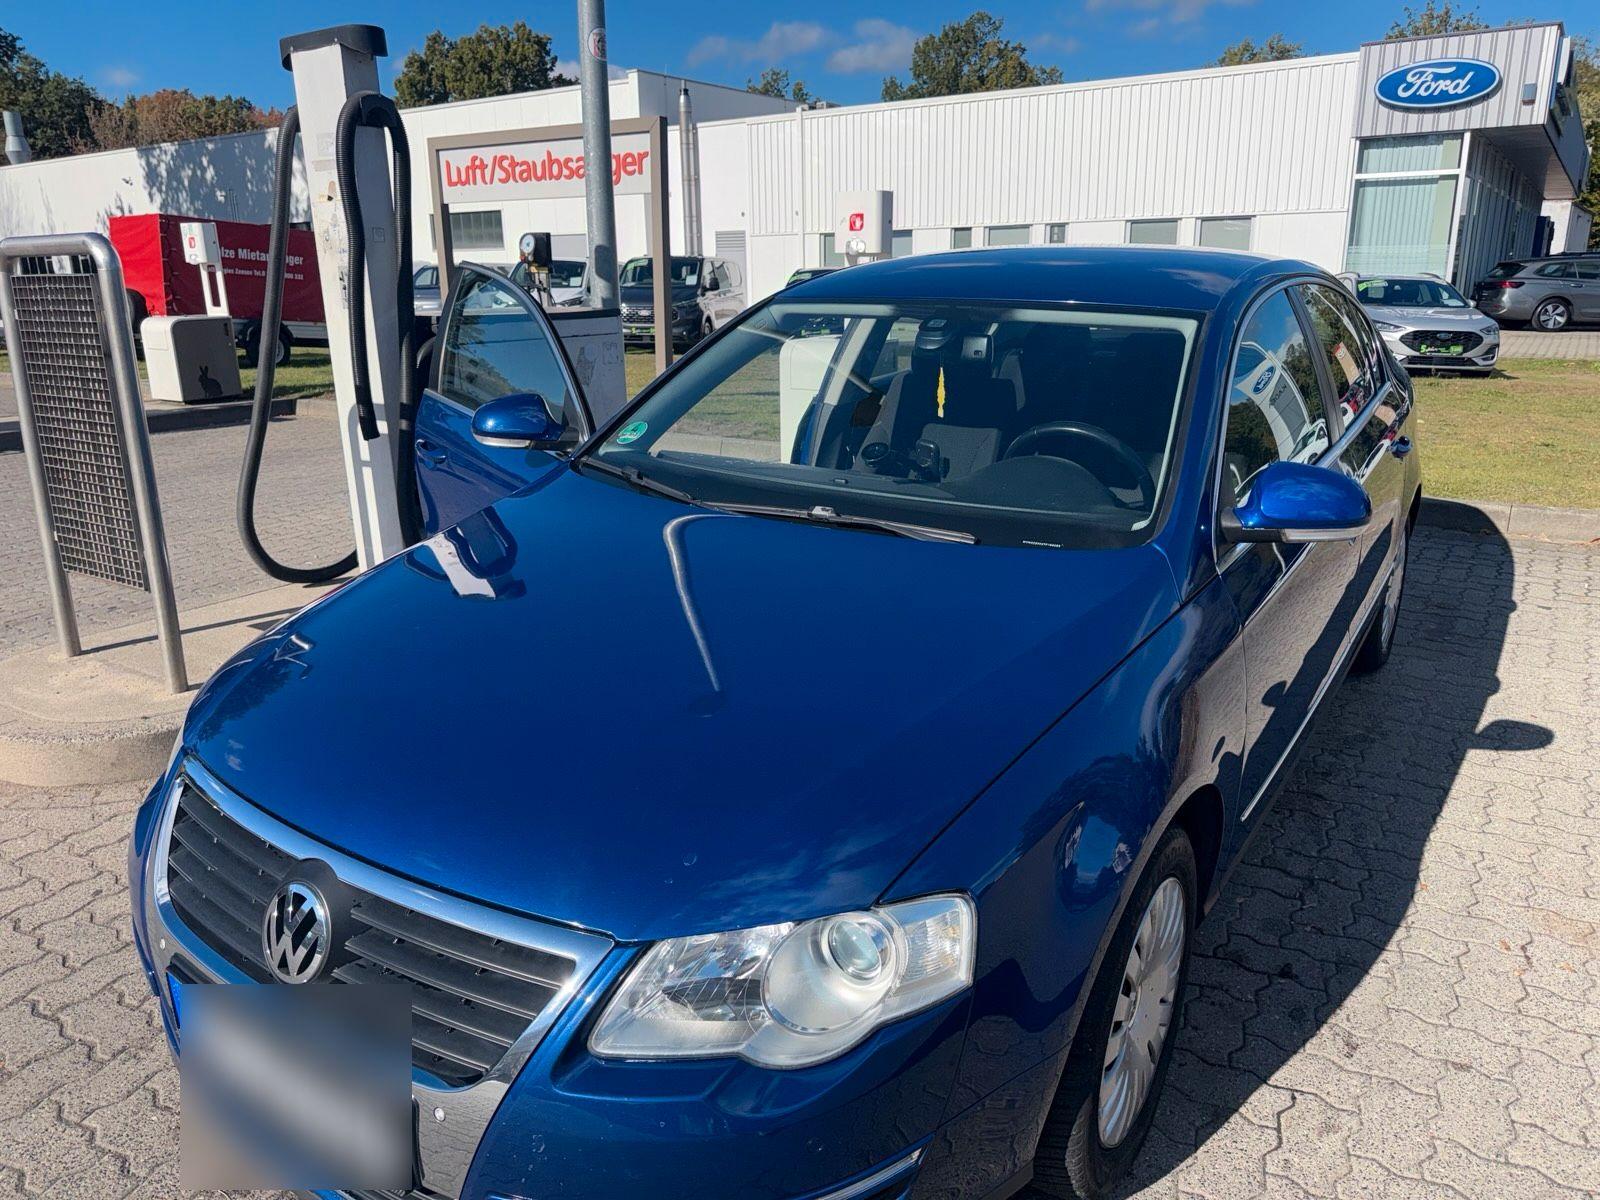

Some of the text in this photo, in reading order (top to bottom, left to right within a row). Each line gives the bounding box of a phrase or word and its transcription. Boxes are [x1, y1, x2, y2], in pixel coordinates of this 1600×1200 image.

[1397, 66, 1475, 98] Ford
[445, 150, 649, 187] Luft/Staubsager
[238, 248, 304, 266] Mietager
[263, 883, 330, 982] VW
